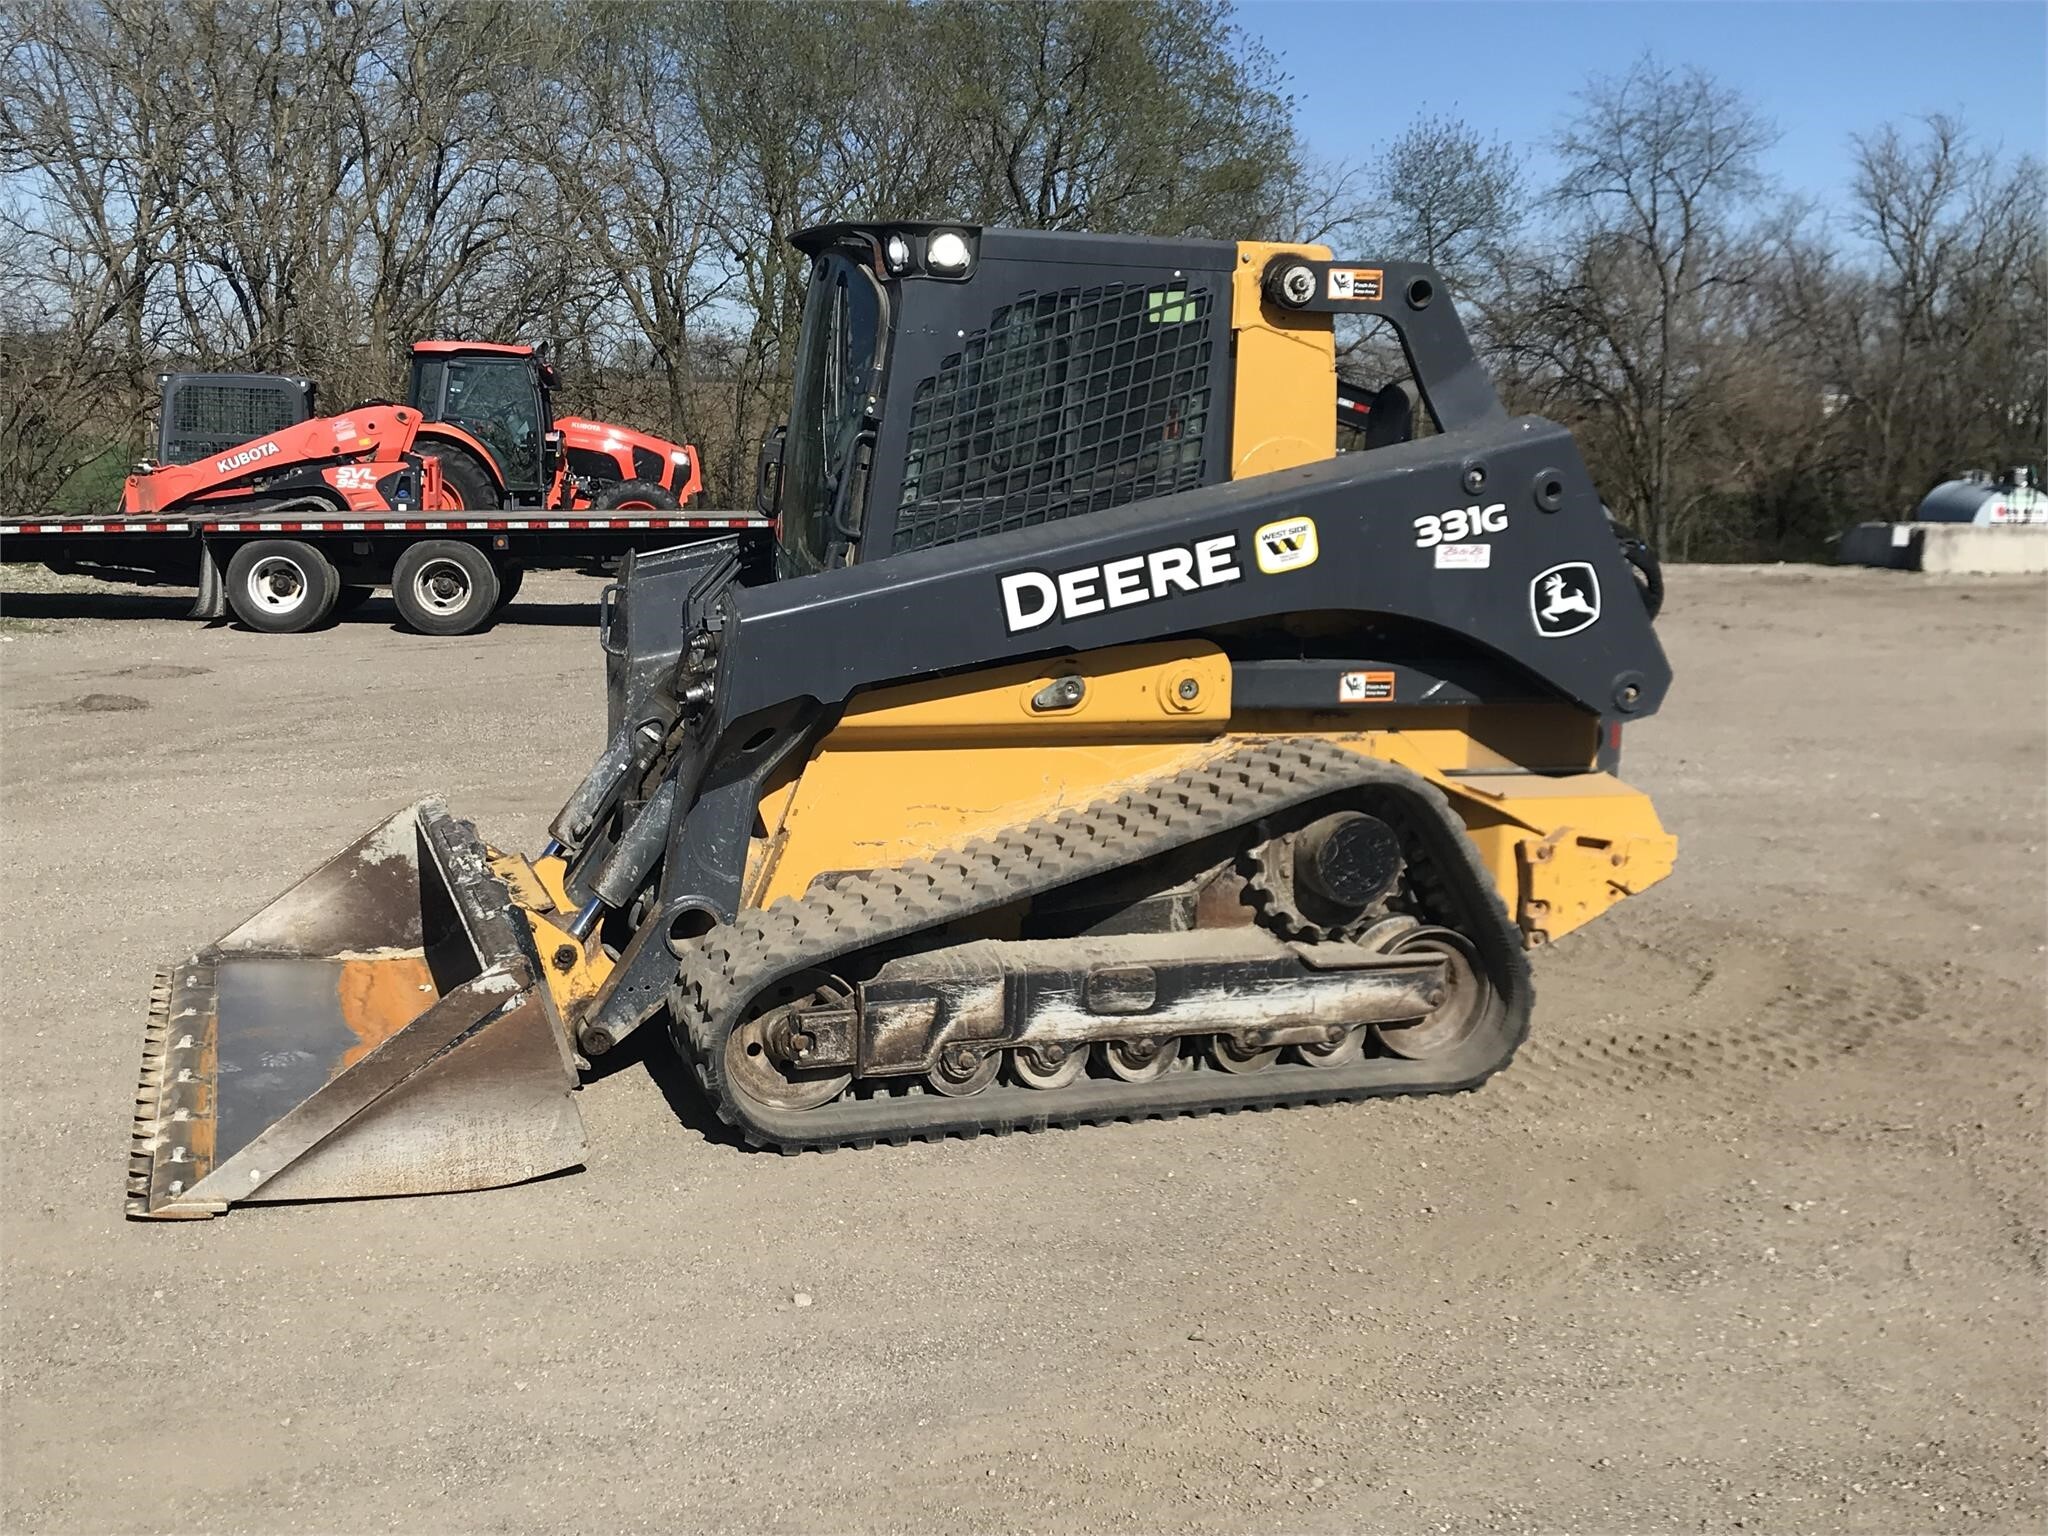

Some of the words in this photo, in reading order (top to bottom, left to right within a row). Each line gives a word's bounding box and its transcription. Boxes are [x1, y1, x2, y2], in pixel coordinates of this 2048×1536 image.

[570, 421, 601, 432] KUBOTA
[216, 441, 280, 473] KUBOTA
[335, 466, 377, 480] SVL
[1262, 530, 1286, 541] WEST
[1288, 524, 1309, 535] SIDE
[1413, 503, 1509, 548] 331G
[1001, 534, 1241, 632] DEERE
